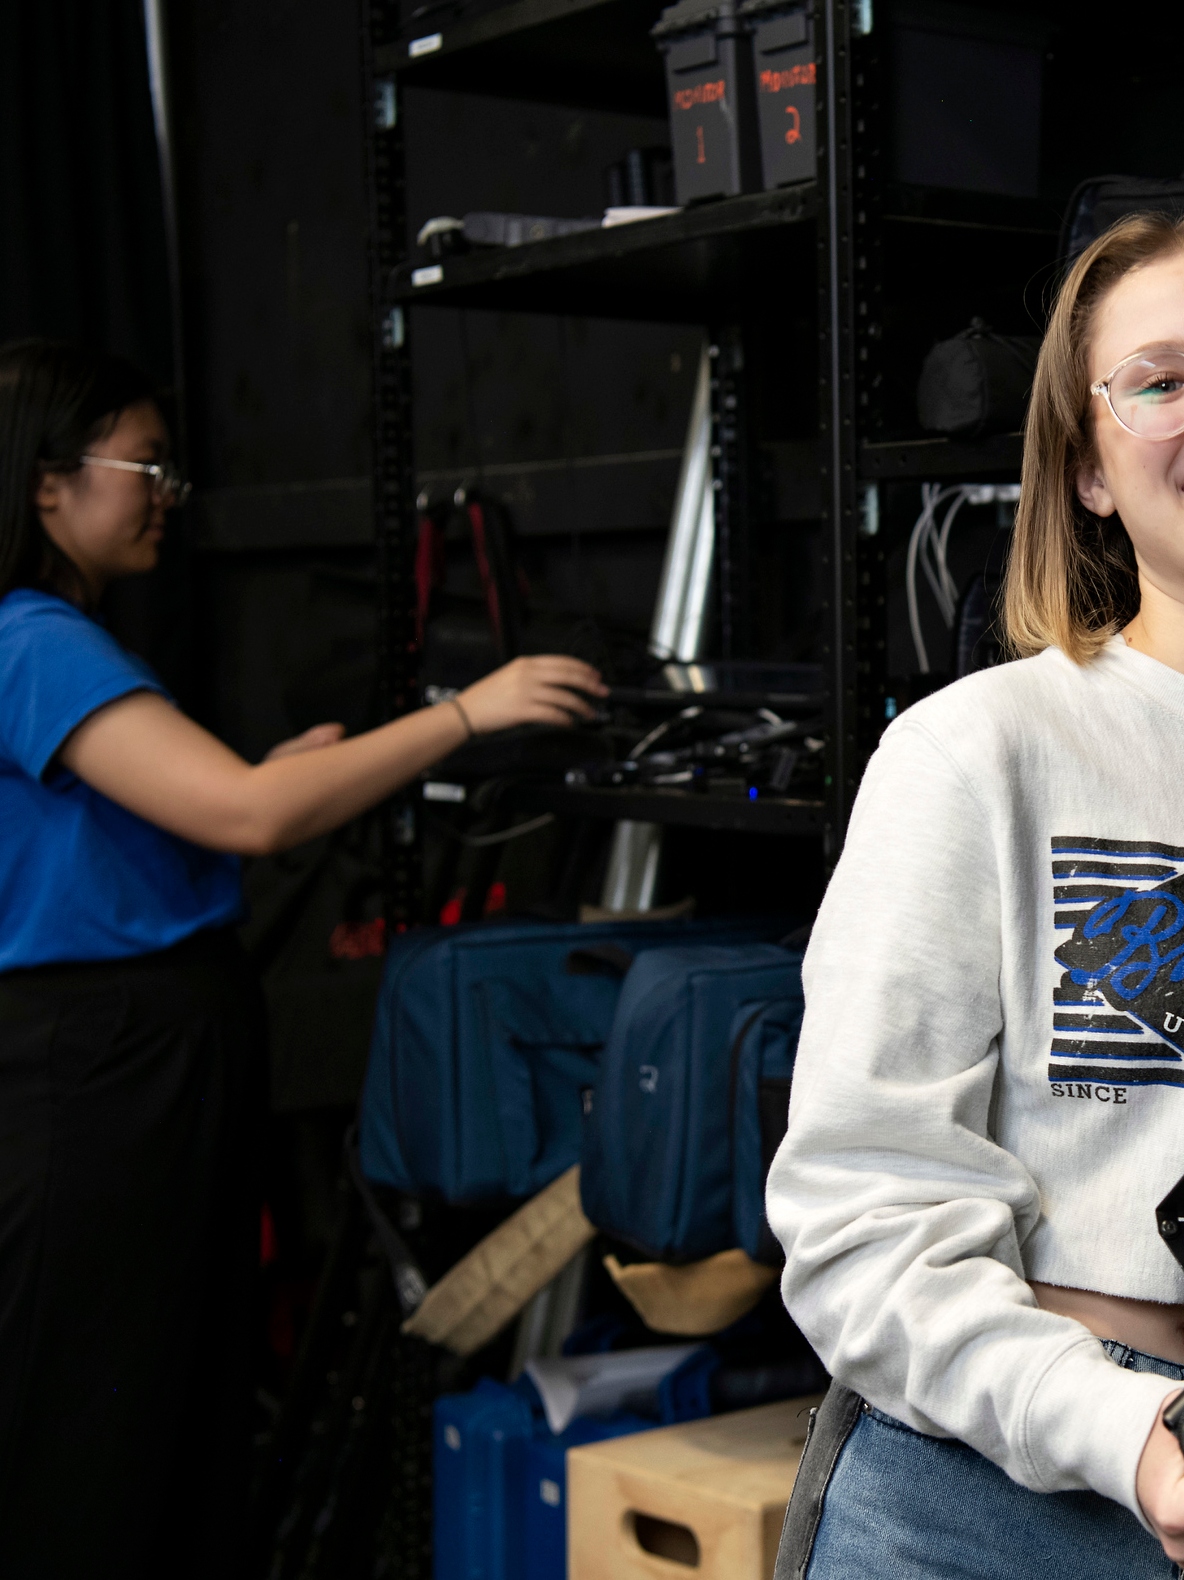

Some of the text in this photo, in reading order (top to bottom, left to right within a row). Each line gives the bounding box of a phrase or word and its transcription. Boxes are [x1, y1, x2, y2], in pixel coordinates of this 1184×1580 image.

[785, 105, 802, 144] 2
[696, 126, 706, 164] 1
[1051, 1082, 1127, 1105] SINCE
